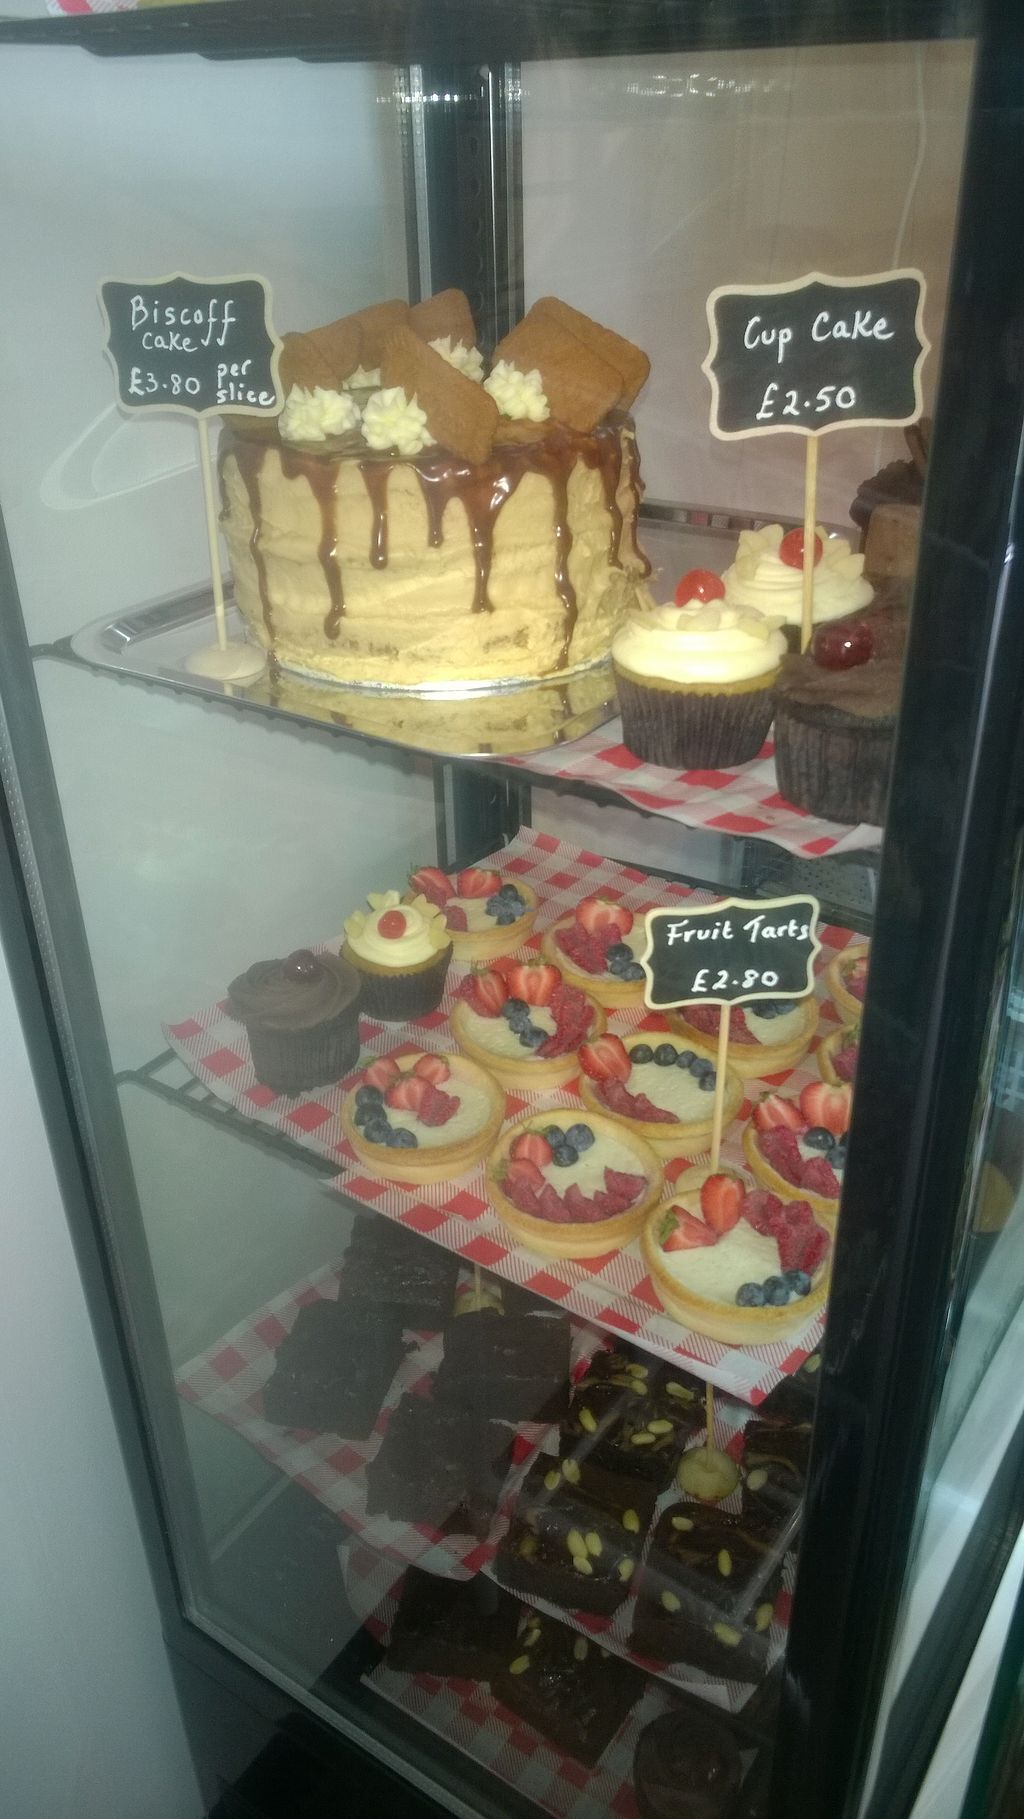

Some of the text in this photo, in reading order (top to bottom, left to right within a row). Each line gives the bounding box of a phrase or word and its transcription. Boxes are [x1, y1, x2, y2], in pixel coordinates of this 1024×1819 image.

[130, 295, 236, 346] Biscoff
[744, 310, 895, 364] Cup Cake
[128, 359, 252, 396] £3.80 per
[216, 382, 275, 406] slice
[756, 382, 856, 420] £2.50
[667, 914, 809, 946] Fruit Tarts
[691, 969, 780, 993] £2.80
